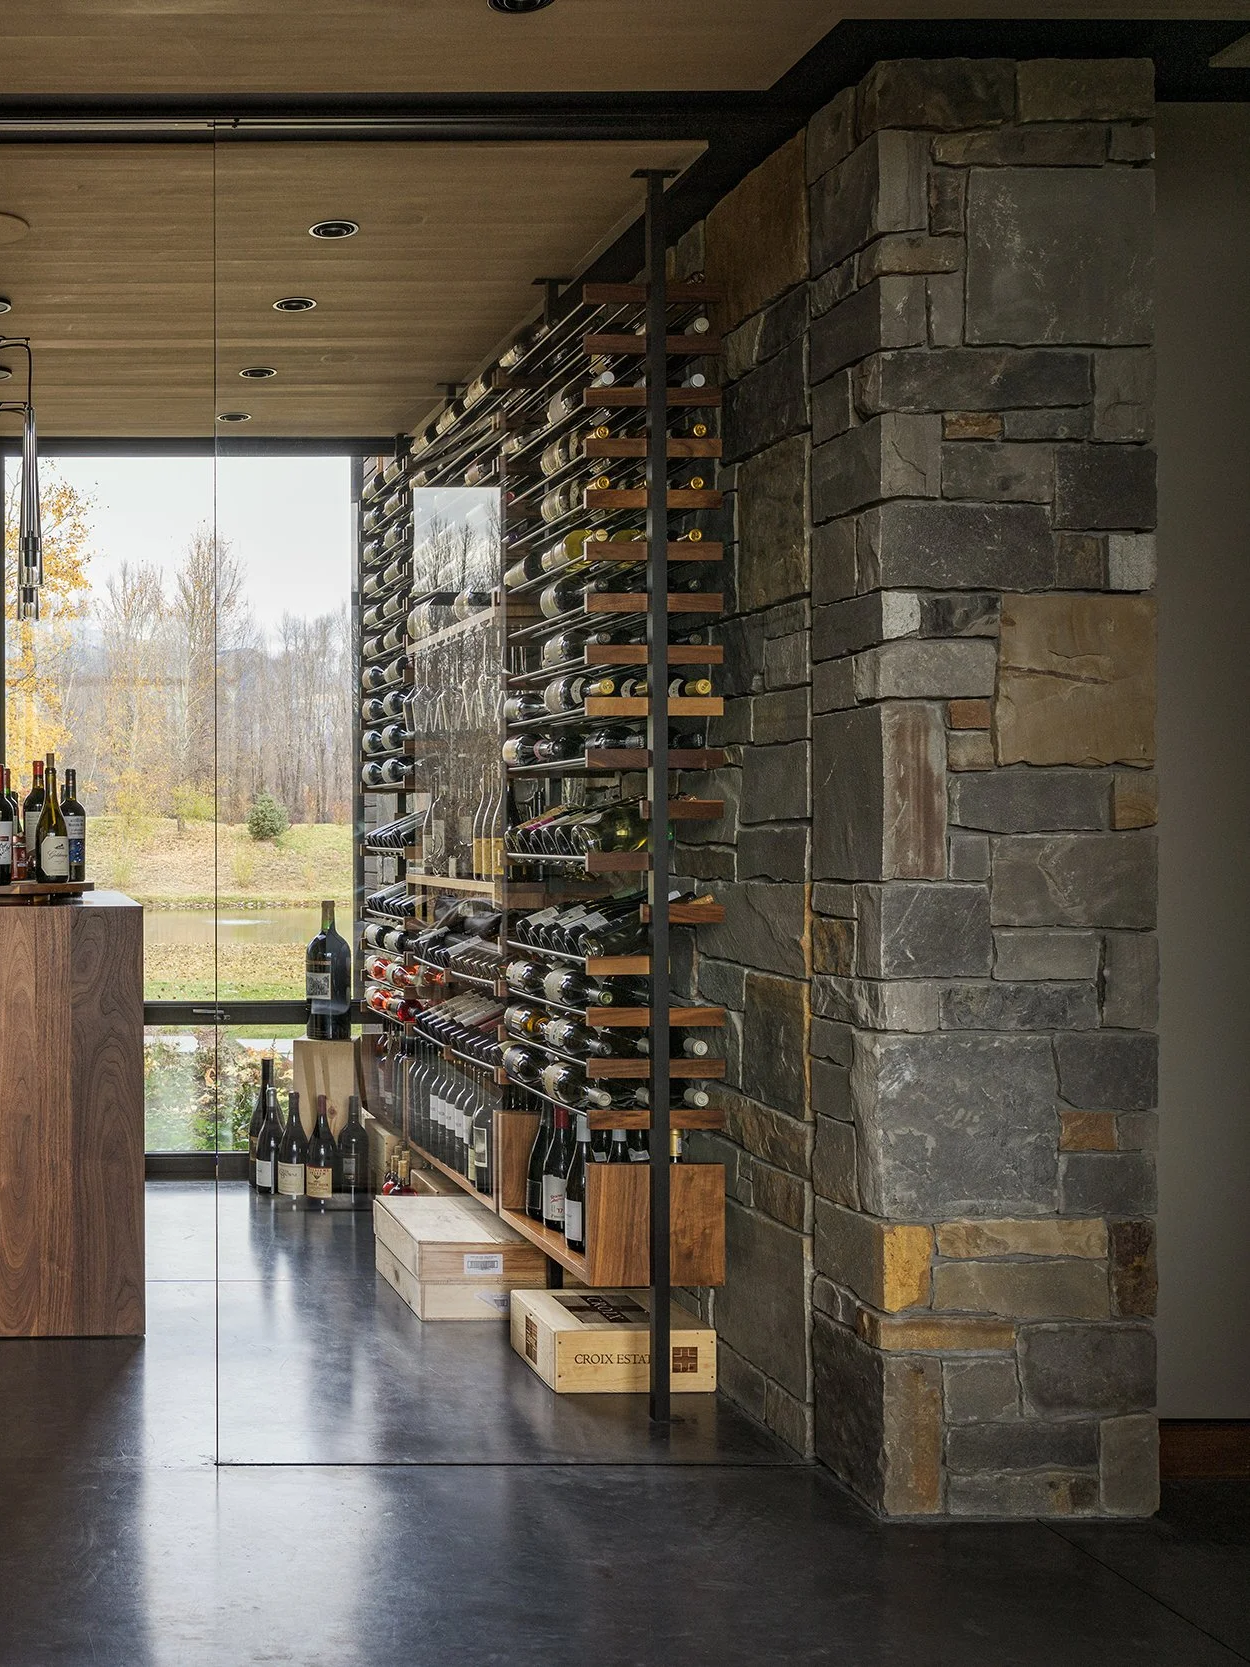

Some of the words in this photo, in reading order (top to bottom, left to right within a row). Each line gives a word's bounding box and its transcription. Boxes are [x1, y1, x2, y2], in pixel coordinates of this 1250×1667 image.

[587, 1296, 624, 1320] CROIX
[574, 1353, 614, 1365] CROIX
[616, 1353, 651, 1365] ESTAT
